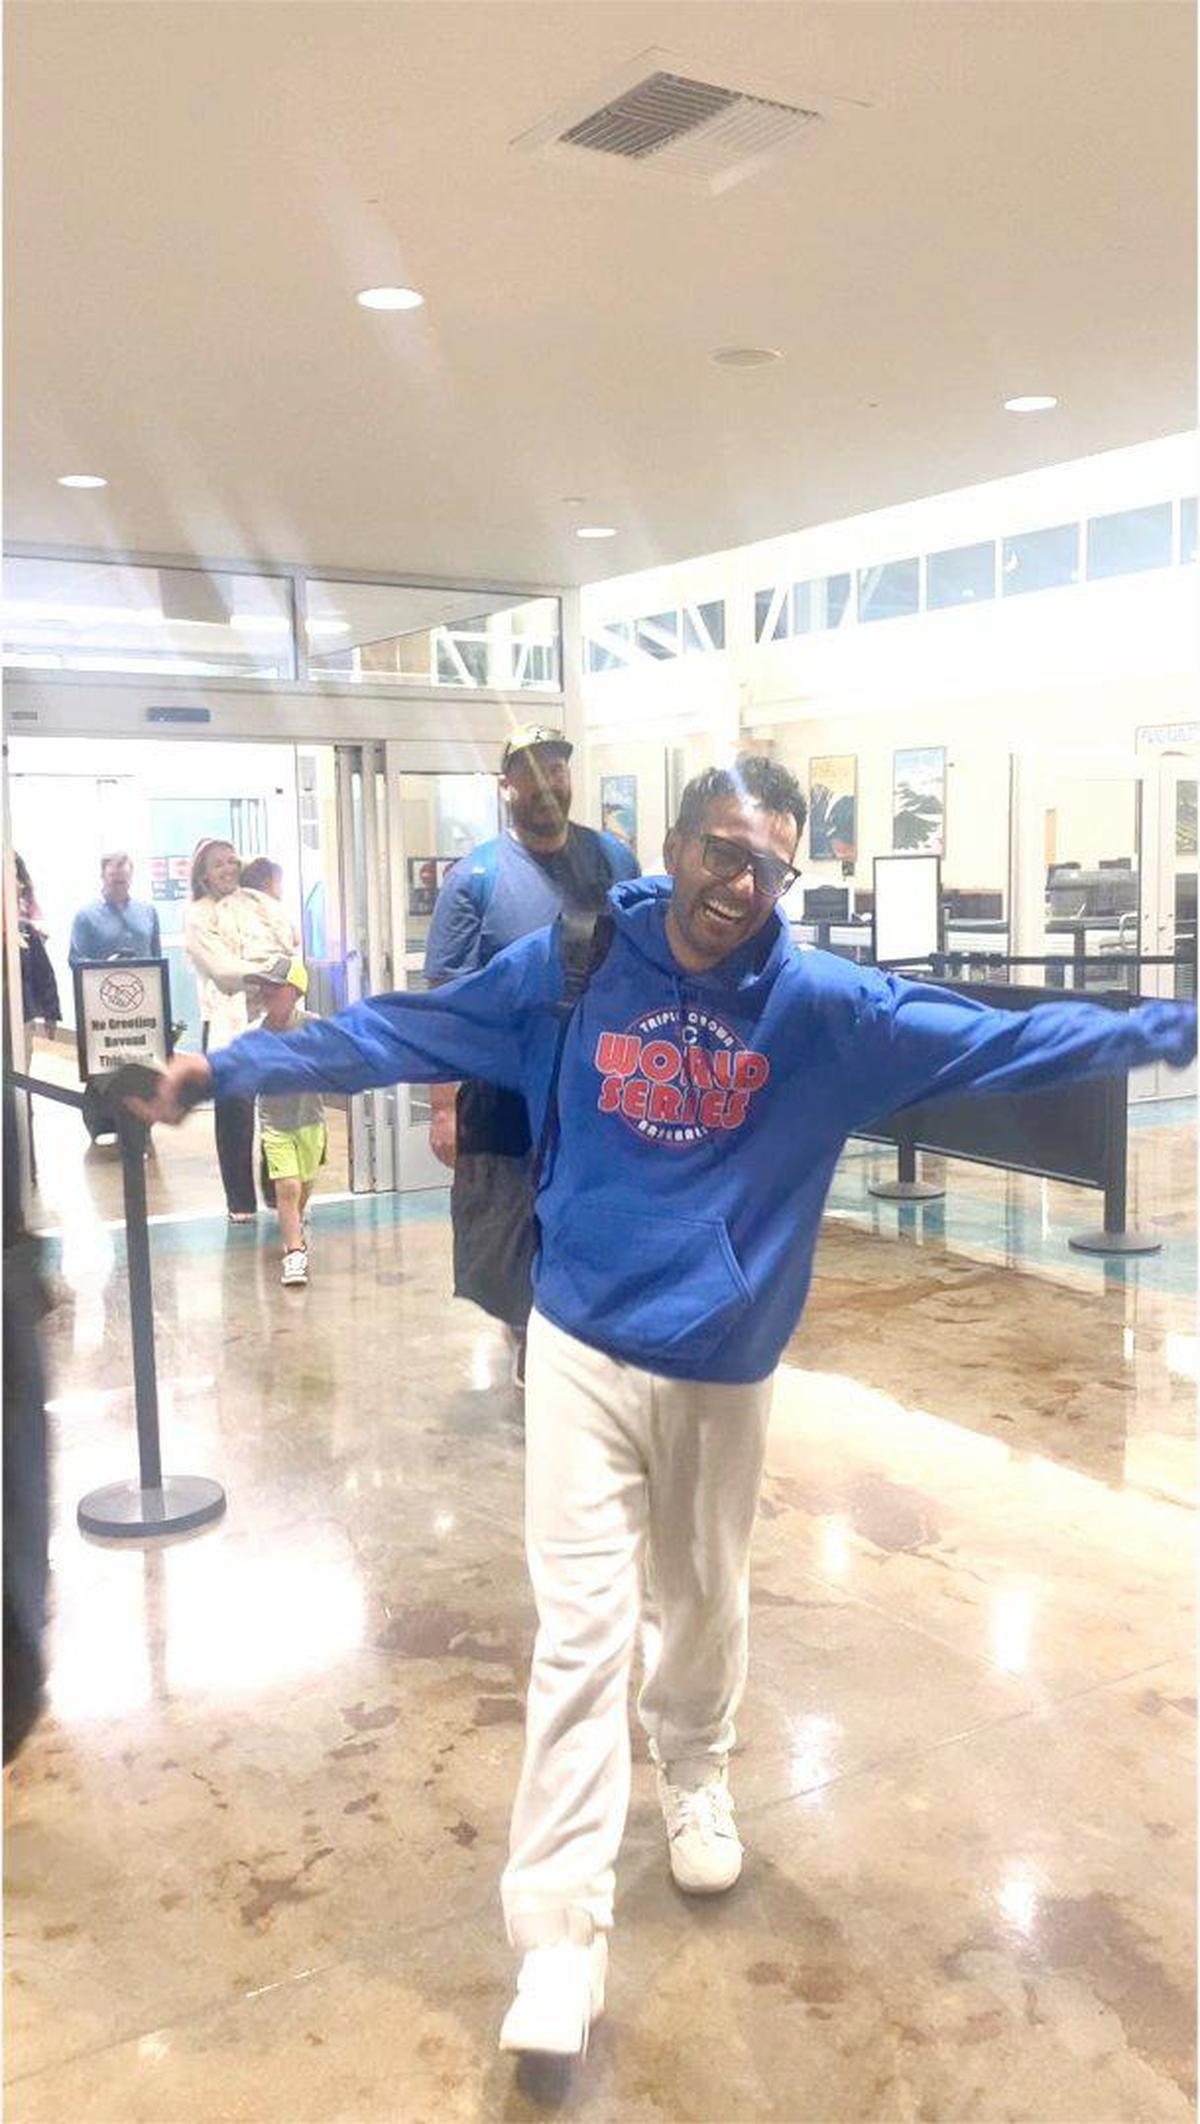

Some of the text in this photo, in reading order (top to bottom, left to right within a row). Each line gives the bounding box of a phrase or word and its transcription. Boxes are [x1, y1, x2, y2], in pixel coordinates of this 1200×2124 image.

[91, 1017, 156, 1031] No Greeting
[595, 1032, 770, 1092] WORLD
[598, 1075, 750, 1129] SERIES
